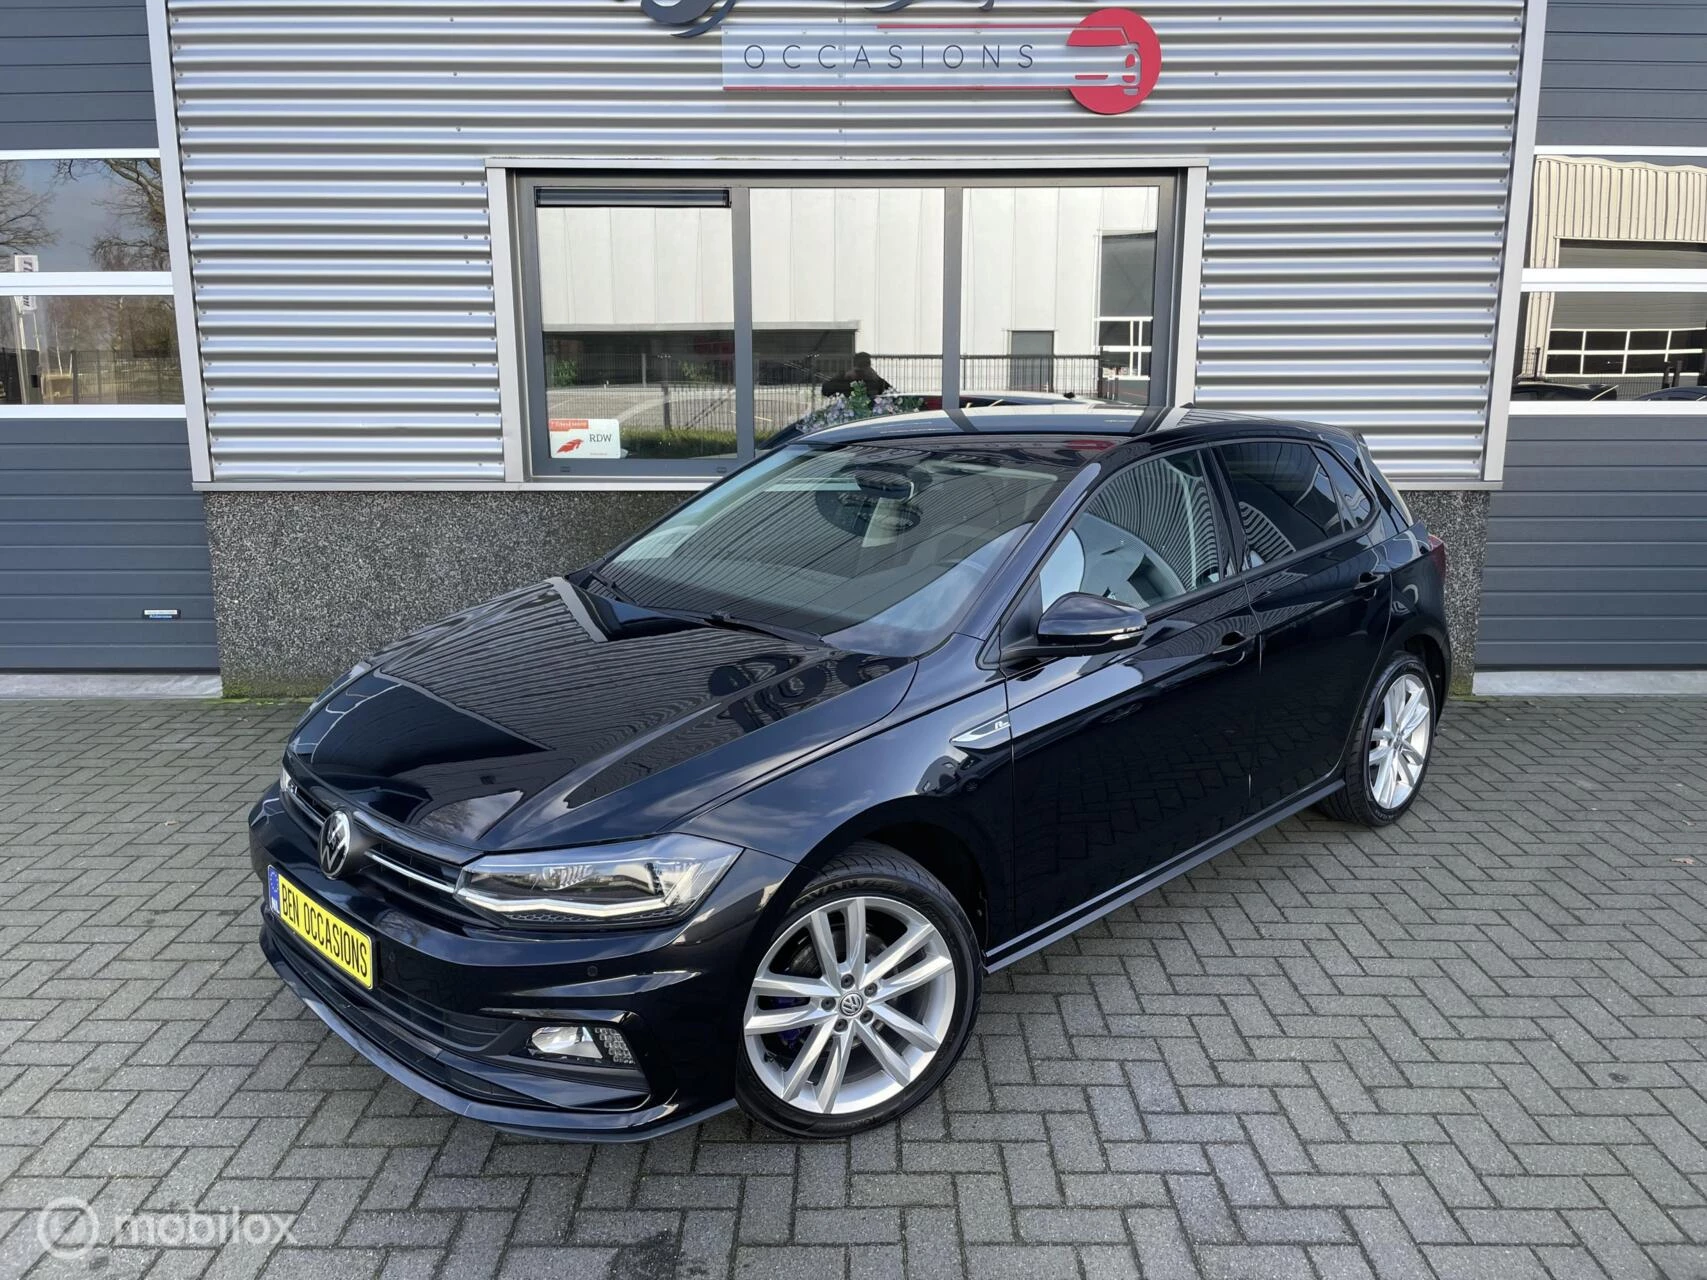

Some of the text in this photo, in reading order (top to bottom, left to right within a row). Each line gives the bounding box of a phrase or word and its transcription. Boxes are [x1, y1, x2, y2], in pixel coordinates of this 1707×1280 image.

[743, 44, 1034, 69] OCCASIONS
[589, 433, 612, 443] RDW
[281, 883, 368, 978] BEN OCCASIONS
